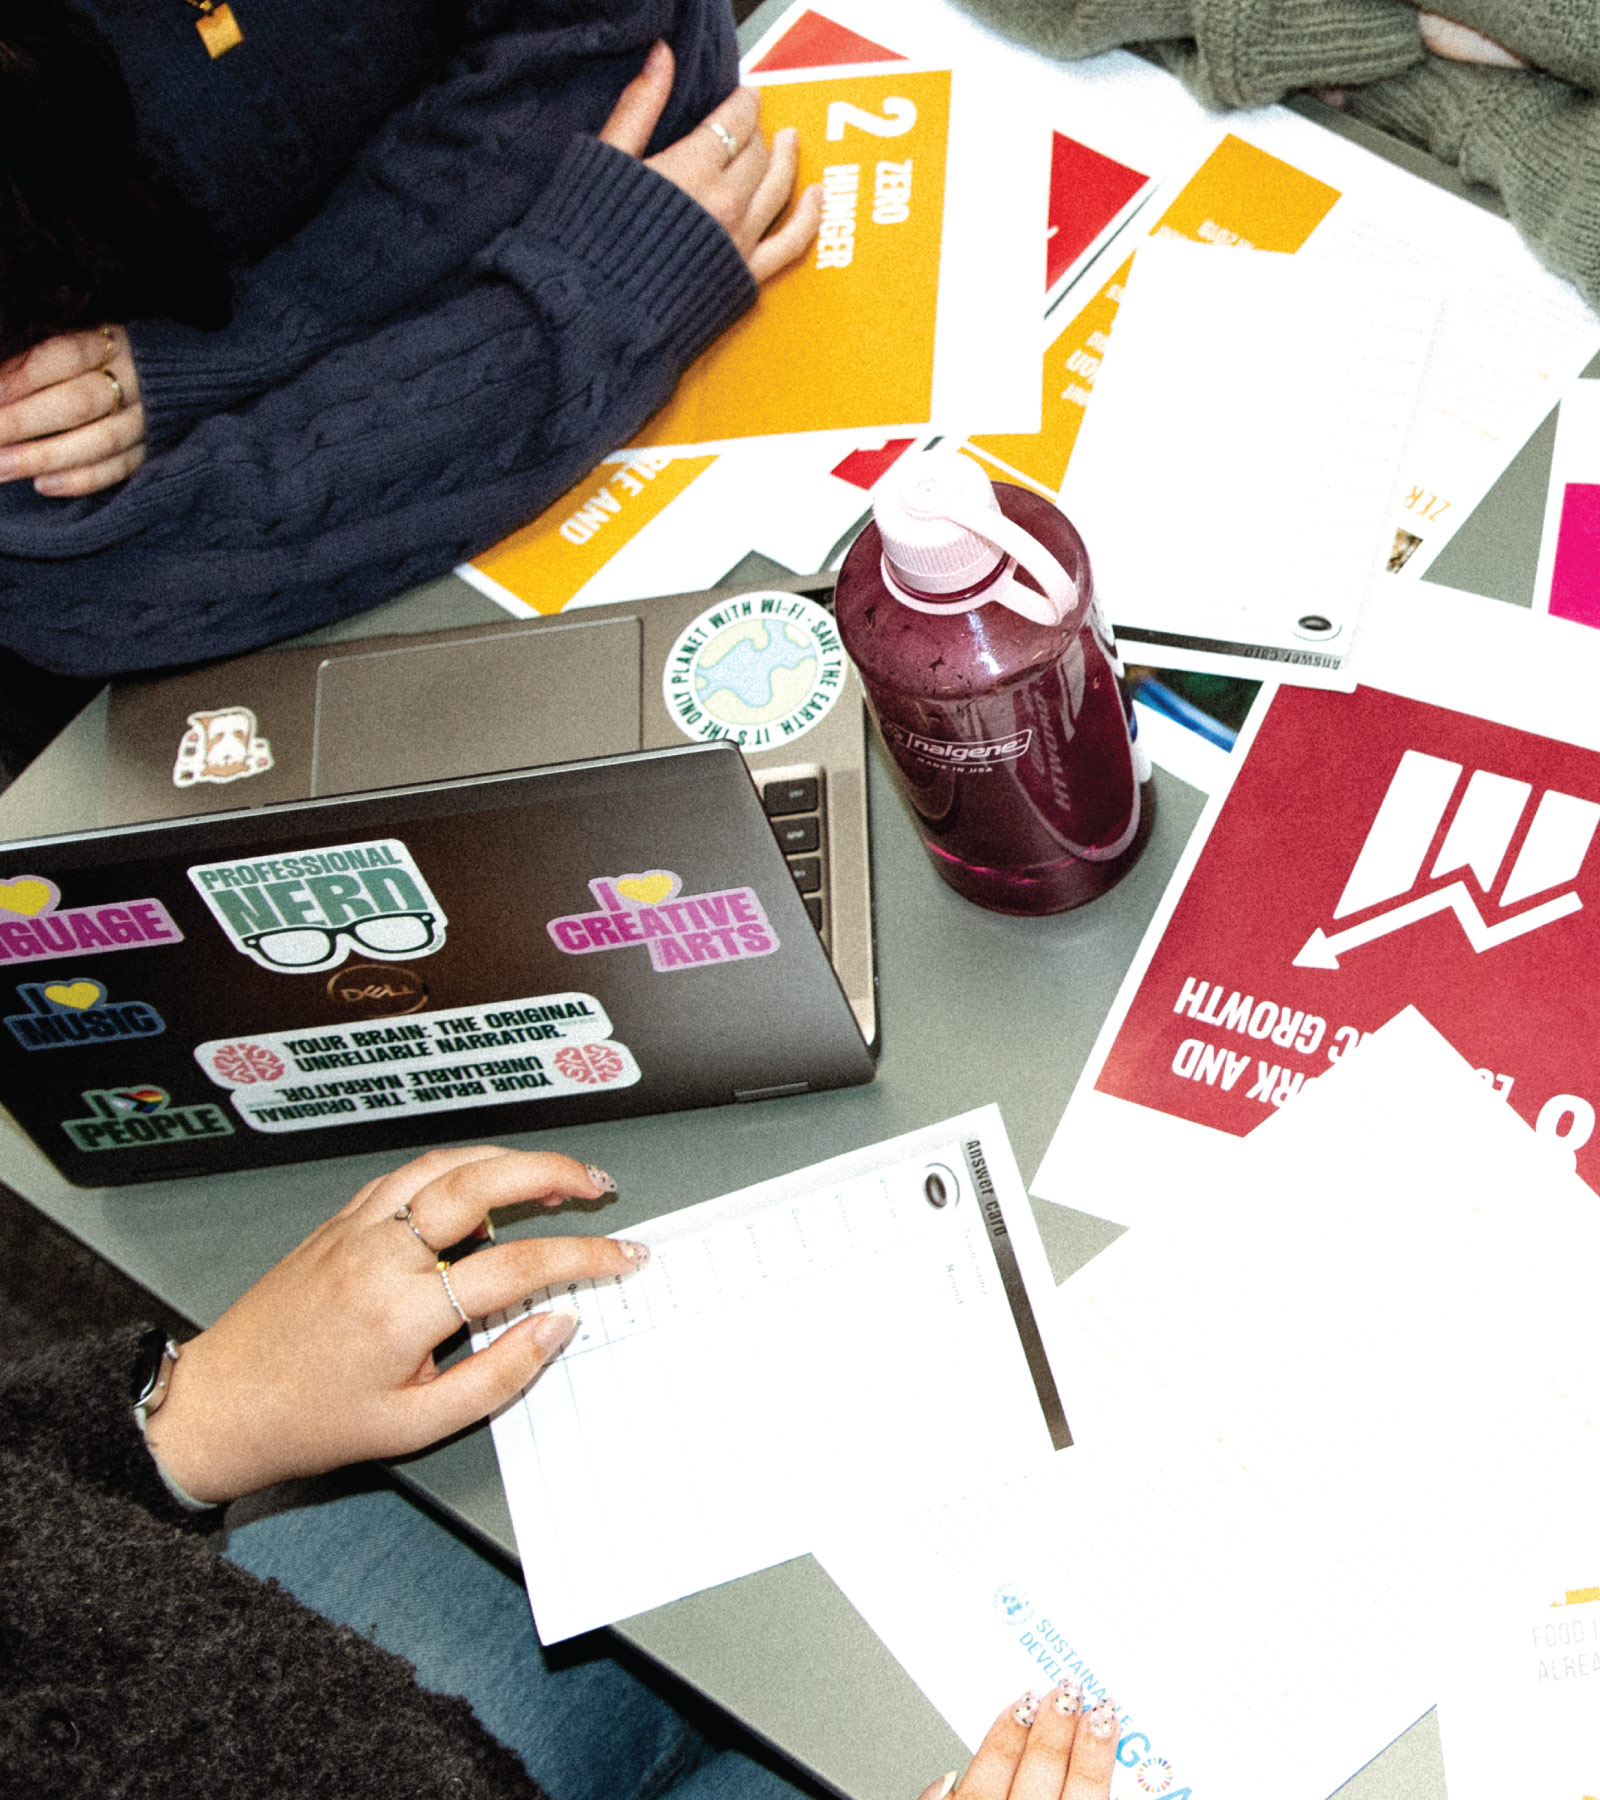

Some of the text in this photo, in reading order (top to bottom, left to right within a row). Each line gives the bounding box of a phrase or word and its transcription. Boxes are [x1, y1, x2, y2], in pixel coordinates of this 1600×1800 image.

[826, 96, 917, 142] 2
[872, 157, 913, 225] ZERO
[816, 163, 859, 269] HUNGER
[560, 487, 622, 545] AND
[708, 600, 752, 630] WITH
[671, 627, 709, 685] PLANET
[811, 620, 841, 655] SAVE
[819, 659, 841, 688] THE
[672, 690, 703, 725] ONLY
[914, 737, 1017, 762] nalgene
[198, 844, 402, 891] PROFESSIONAL
[210, 867, 429, 937] NERD
[596, 882, 622, 912] I
[554, 892, 759, 951] CREATIVE
[658, 922, 772, 966] ARTS
[24, 987, 51, 1015] I
[1173, 976, 1327, 1055] GROWTH
[13, 1004, 156, 1045] MUSIC
[283, 1034, 348, 1056] YOUR
[351, 1023, 432, 1048] BRAIN:
[433, 1016, 481, 1036] THE
[484, 1001, 596, 1029] ORIGINAL
[294, 1023, 567, 1072] UNRELIABLE NARRATOR.
[1171, 1038, 1252, 1092] AND
[275, 1056, 544, 1103] UNRELIABLE NARRATOR.
[360, 1091, 406, 1110] THE
[407, 1080, 487, 1103] BRAIN:
[491, 1072, 553, 1093] YOUR
[74, 1107, 226, 1148] PEOPLE
[90, 1094, 117, 1119] I
[250, 1098, 357, 1124] ORIGINAL
[967, 1139, 1008, 1238] Answer card
[1531, 1619, 1585, 1648] FOOD
